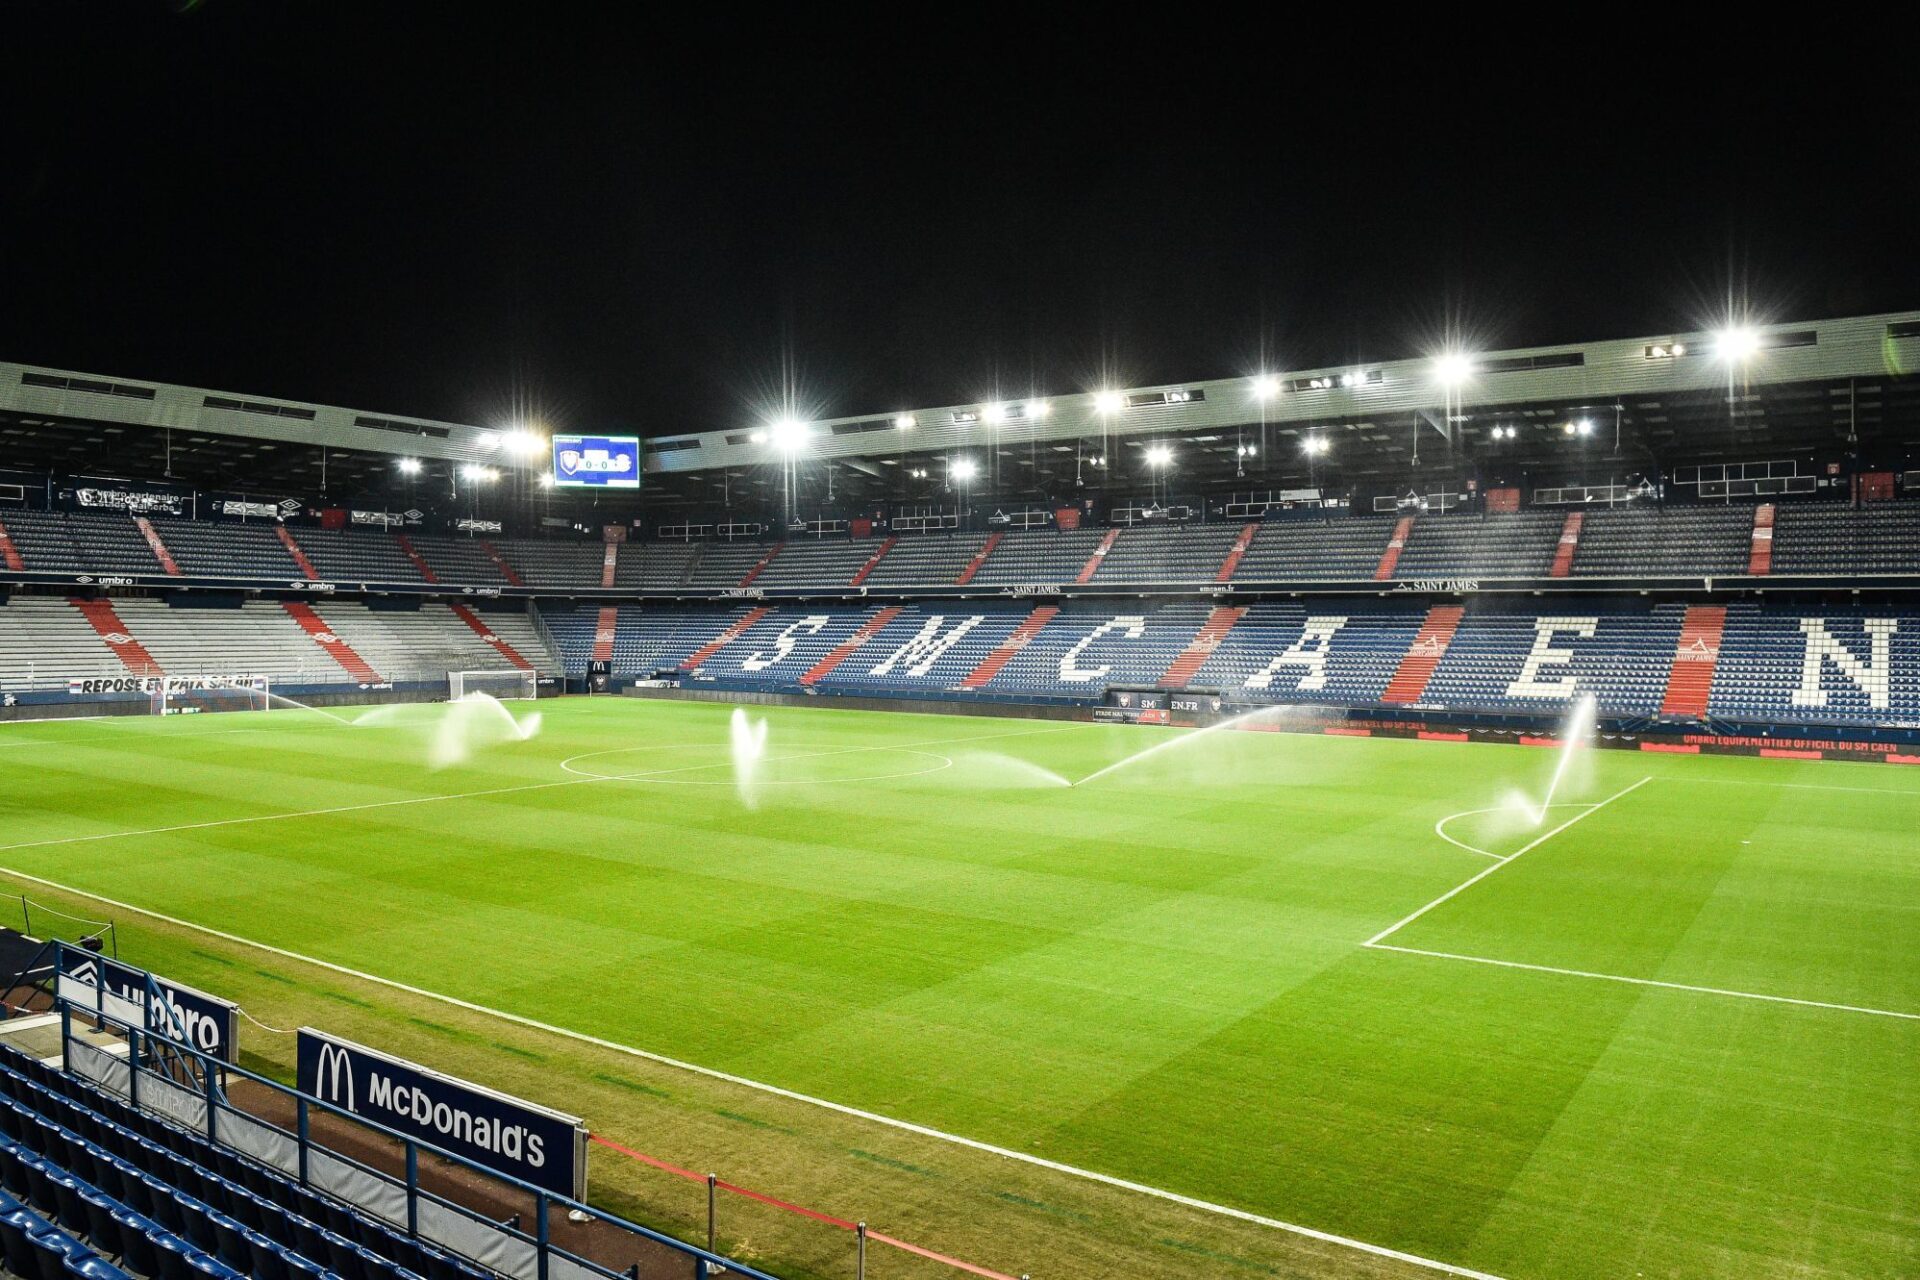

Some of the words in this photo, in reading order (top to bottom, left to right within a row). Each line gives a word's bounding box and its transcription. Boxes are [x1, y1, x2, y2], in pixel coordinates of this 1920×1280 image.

[99, 577, 133, 585] umbro
[1413, 581, 1444, 590] SAINT
[1445, 581, 1479, 590] JAMES
[308, 582, 335, 590] umbro
[82, 678, 142, 693] REPOSE
[146, 677, 164, 691] EN
[1141, 700, 1156, 709] SM
[1684, 735, 1716, 744] UMBRO
[1718, 737, 1792, 748] EQUIPEMENTIER
[1794, 739, 1836, 750] OFFICIEL
[1839, 742, 1852, 750] DU
[1855, 742, 1869, 751] SM
[1871, 743, 1897, 752] CAEN
[369, 1072, 545, 1168] McDonald's
